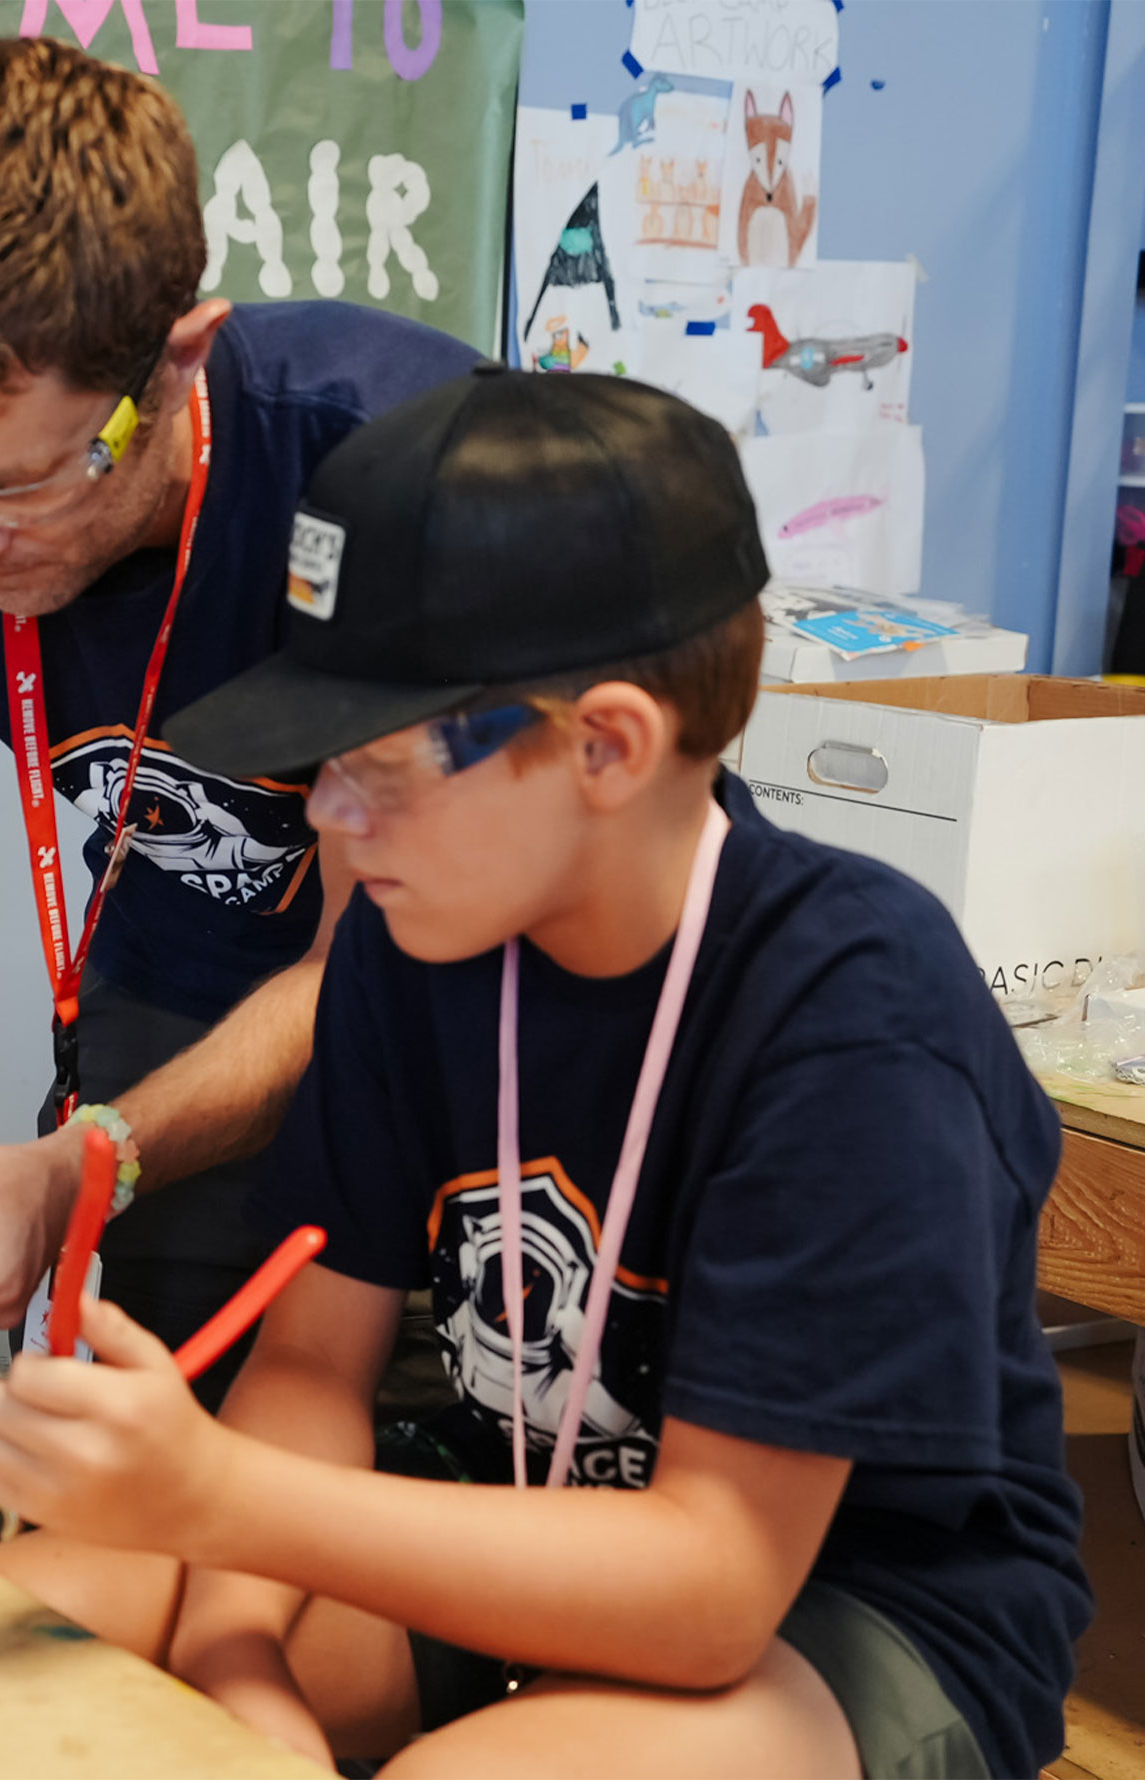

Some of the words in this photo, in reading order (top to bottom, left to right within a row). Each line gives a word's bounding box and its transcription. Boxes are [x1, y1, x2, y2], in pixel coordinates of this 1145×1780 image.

[650, 12, 834, 72] ARTWORK
[199, 139, 439, 301] AIR
[749, 783, 804, 806] CONTENTS:
